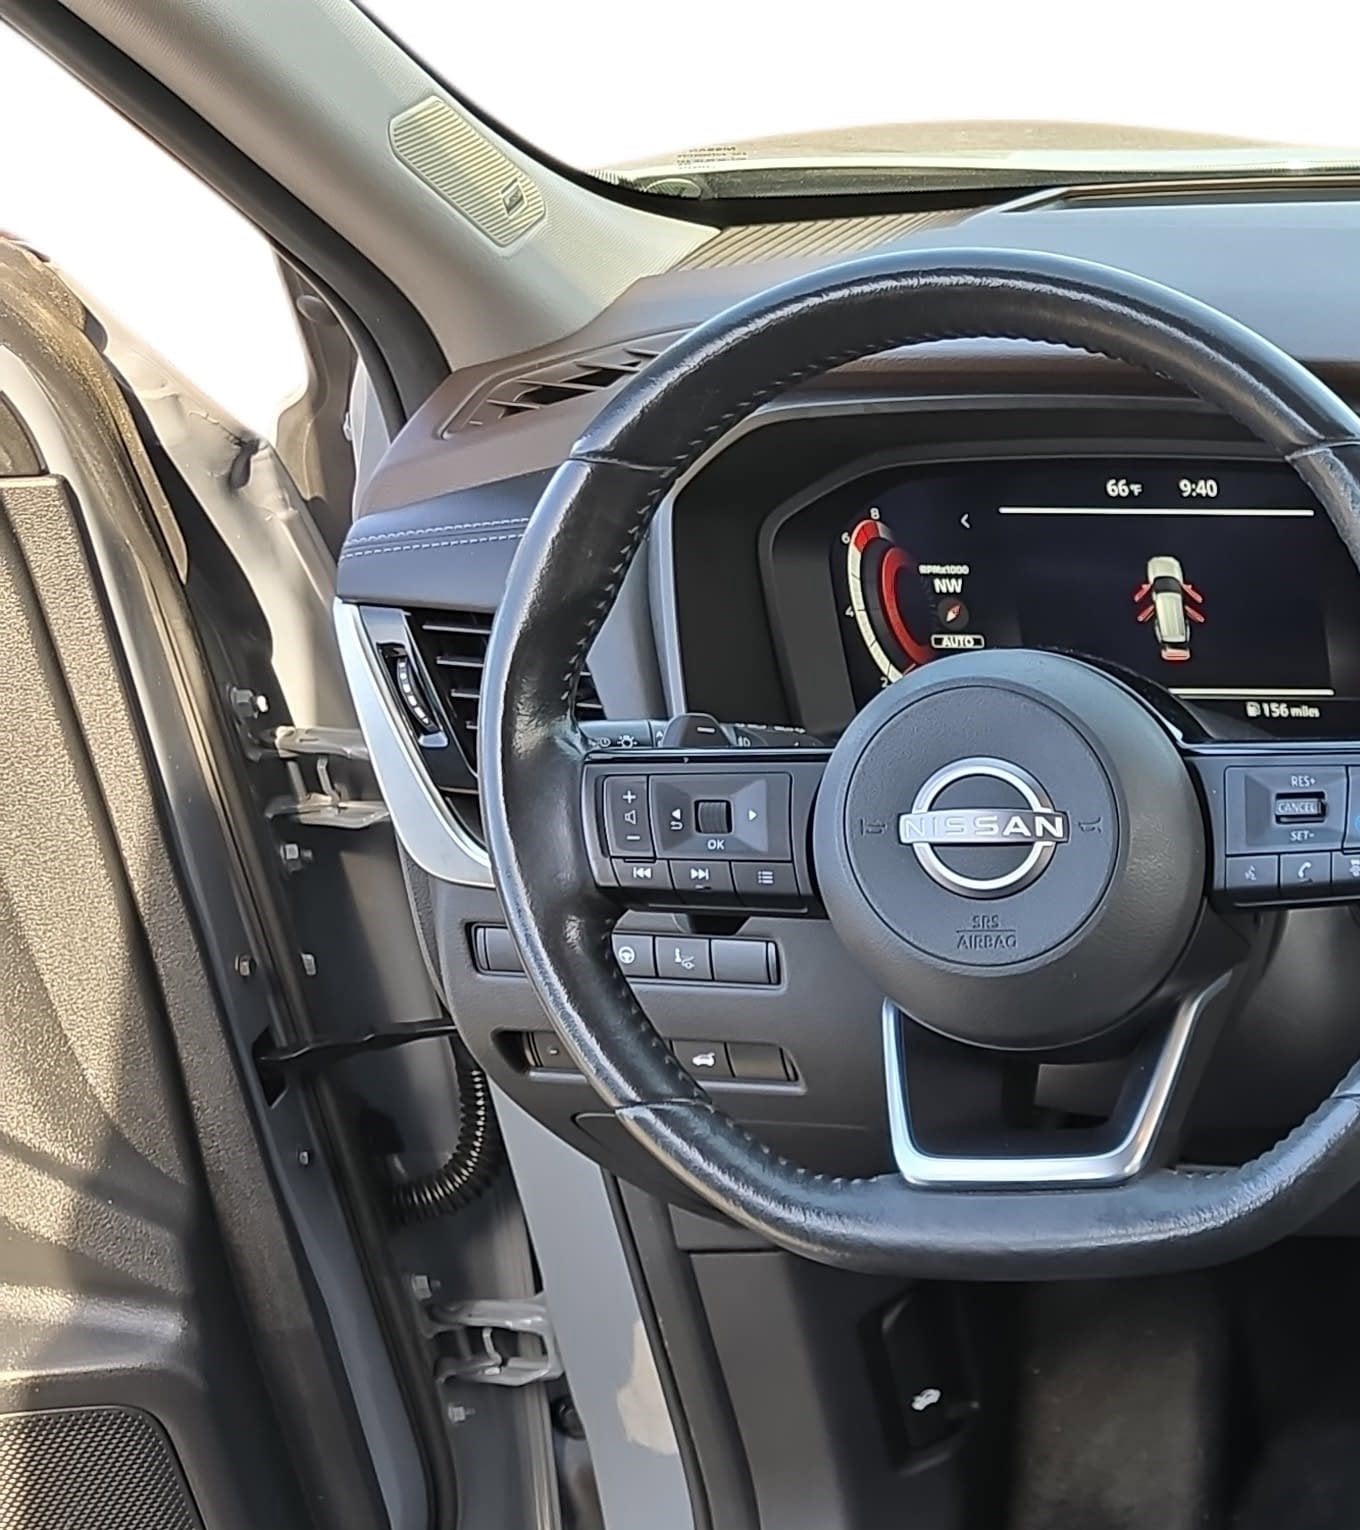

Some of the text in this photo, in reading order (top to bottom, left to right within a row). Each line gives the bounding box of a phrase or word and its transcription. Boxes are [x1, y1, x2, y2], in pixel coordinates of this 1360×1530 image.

[1179, 479, 1218, 497] 9:40
[870, 508, 880, 519] 8
[841, 532, 850, 544] 6
[933, 578, 962, 593] NW
[845, 606, 855, 616] 4
[942, 637, 974, 647] AUTO
[1262, 702, 1320, 718] 156 miles
[904, 815, 1064, 839] NISSAN
[708, 839, 725, 850] OK
[972, 914, 999, 929] SRS
[957, 933, 1017, 949] AIRBAG
